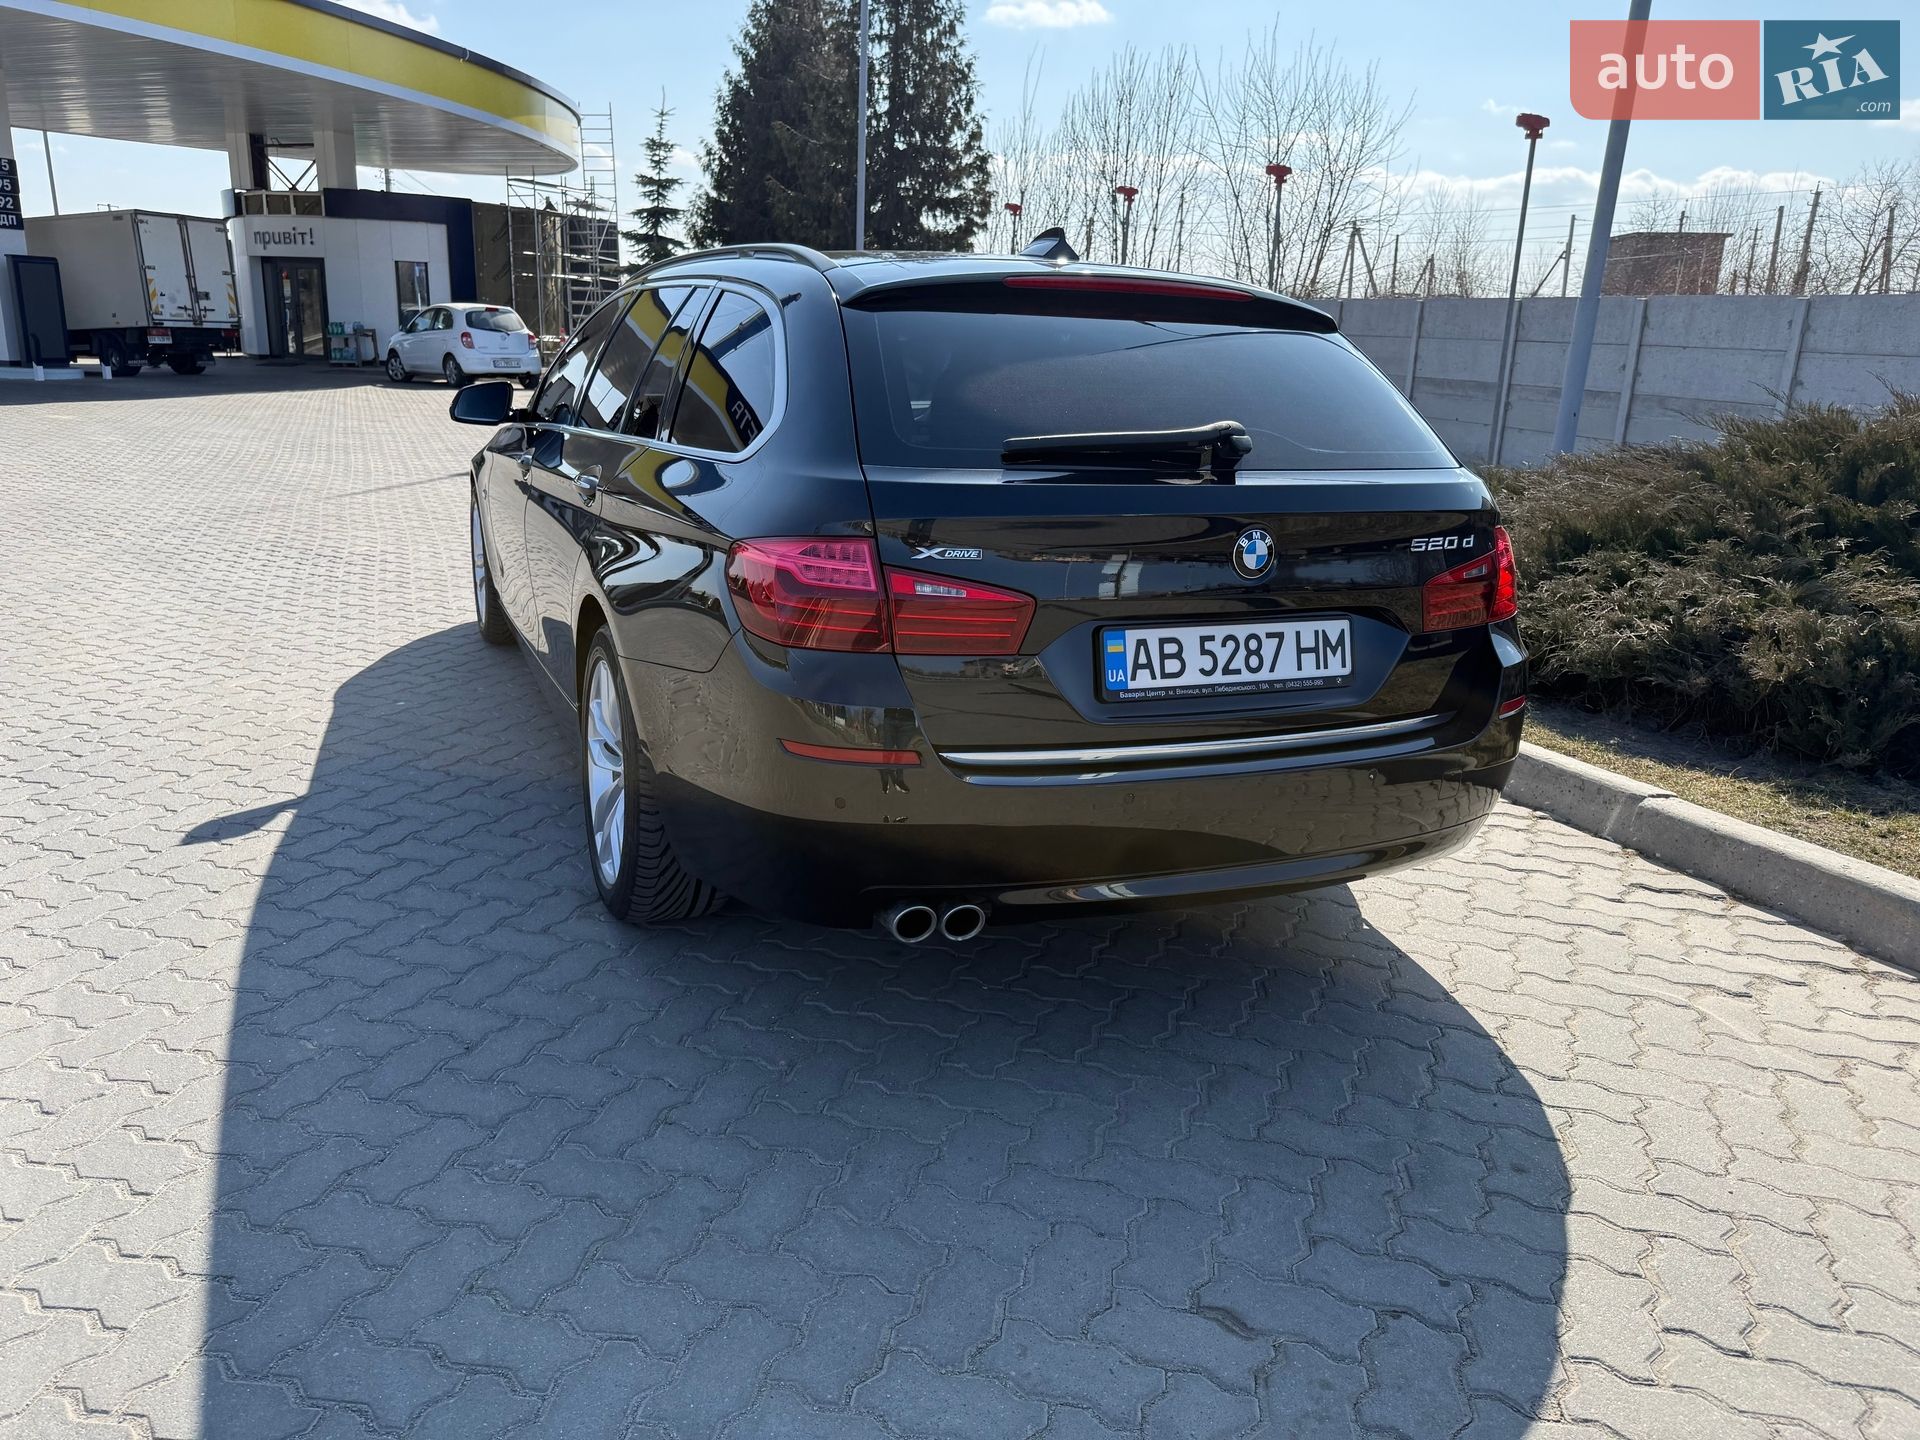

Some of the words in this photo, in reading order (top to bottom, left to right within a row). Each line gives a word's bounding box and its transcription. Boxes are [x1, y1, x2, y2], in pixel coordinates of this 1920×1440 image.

[253, 216, 315, 251] привіт!
[1240, 531, 1272, 547] BMW
[1410, 536, 1458, 552] 520
[1130, 637, 1186, 681] AB
[1198, 631, 1285, 677] 5287
[1295, 628, 1346, 671] HM
[1108, 669, 1125, 682] UA
[1119, 691, 1145, 699] Баварія
[1146, 690, 1166, 698] Центр
